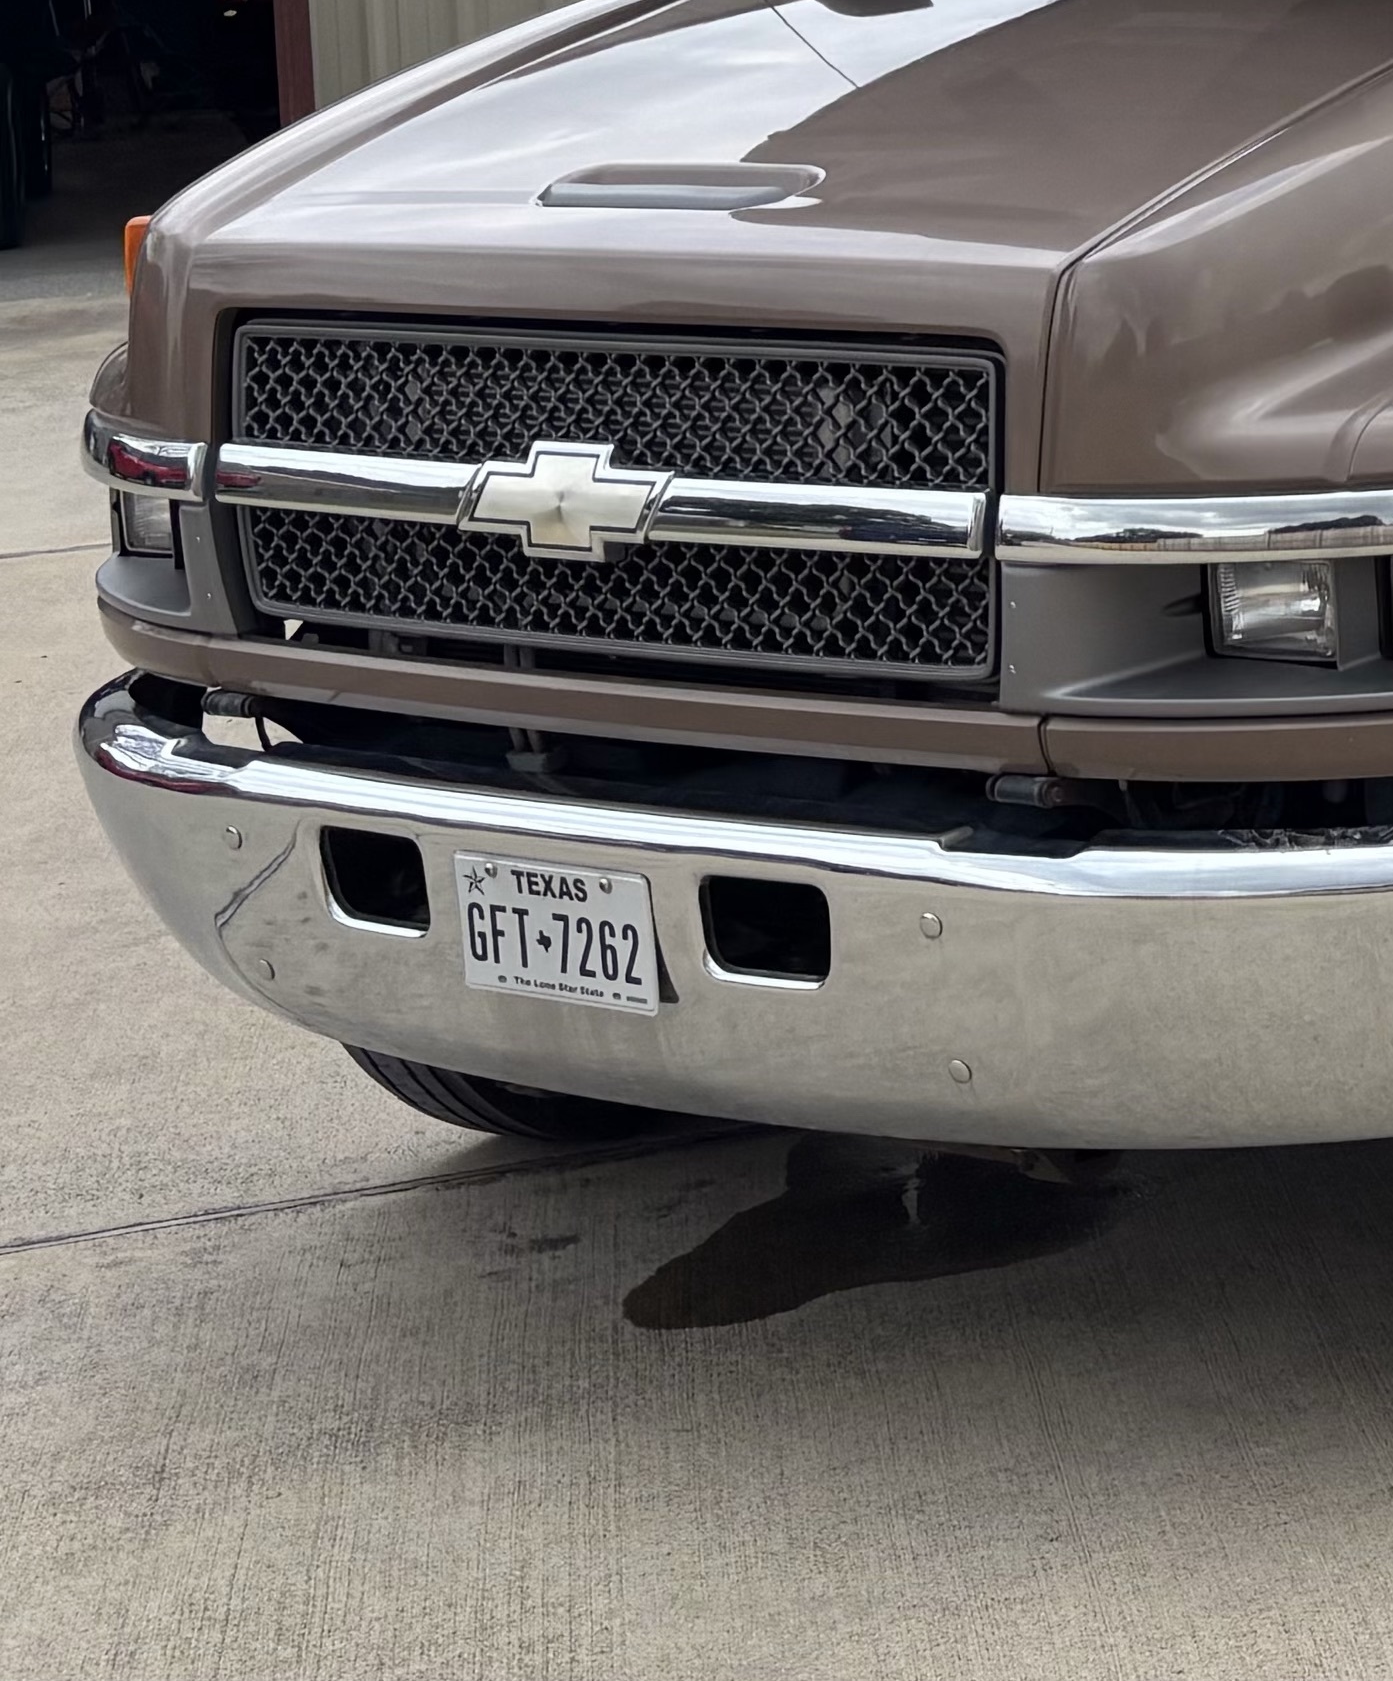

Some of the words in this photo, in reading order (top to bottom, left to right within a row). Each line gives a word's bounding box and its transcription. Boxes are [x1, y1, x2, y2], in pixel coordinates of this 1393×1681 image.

[510, 869, 588, 903] TEXAS
[467, 902, 529, 969] GFT
[551, 912, 643, 986] 7262
[513, 975, 532, 987] The
[533, 979, 556, 991] Lone
[558, 983, 579, 994] Star
[579, 986, 605, 998] State
